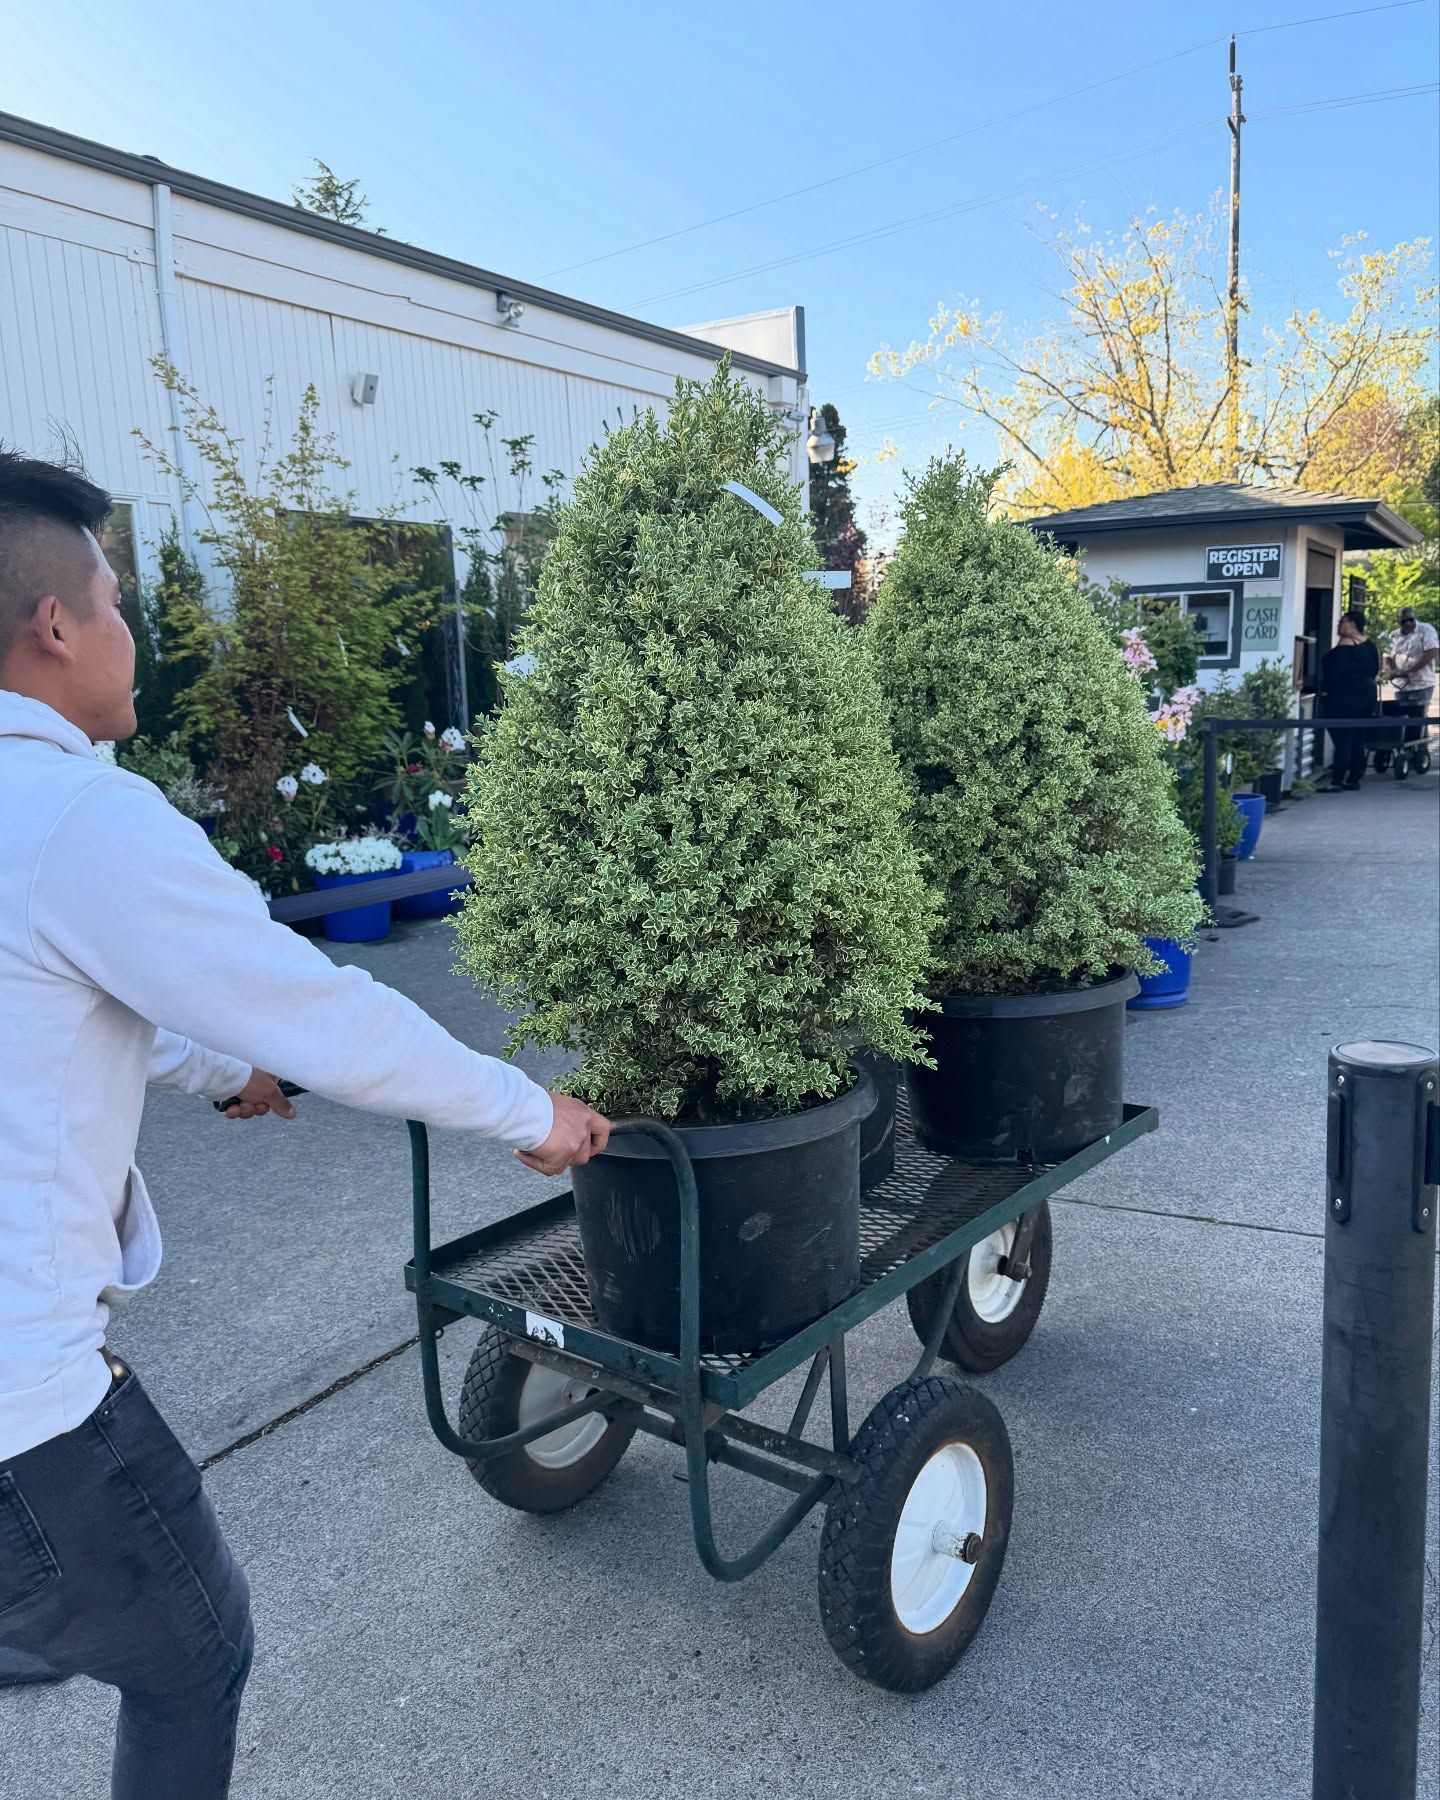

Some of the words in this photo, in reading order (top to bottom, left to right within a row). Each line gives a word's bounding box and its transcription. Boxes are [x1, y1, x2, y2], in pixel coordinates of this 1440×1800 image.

[1209, 548, 1278, 564] REGISTER
[1222, 562, 1264, 576] OPEN
[1246, 608, 1278, 622] CASH
[1244, 625, 1278, 640] CARD
